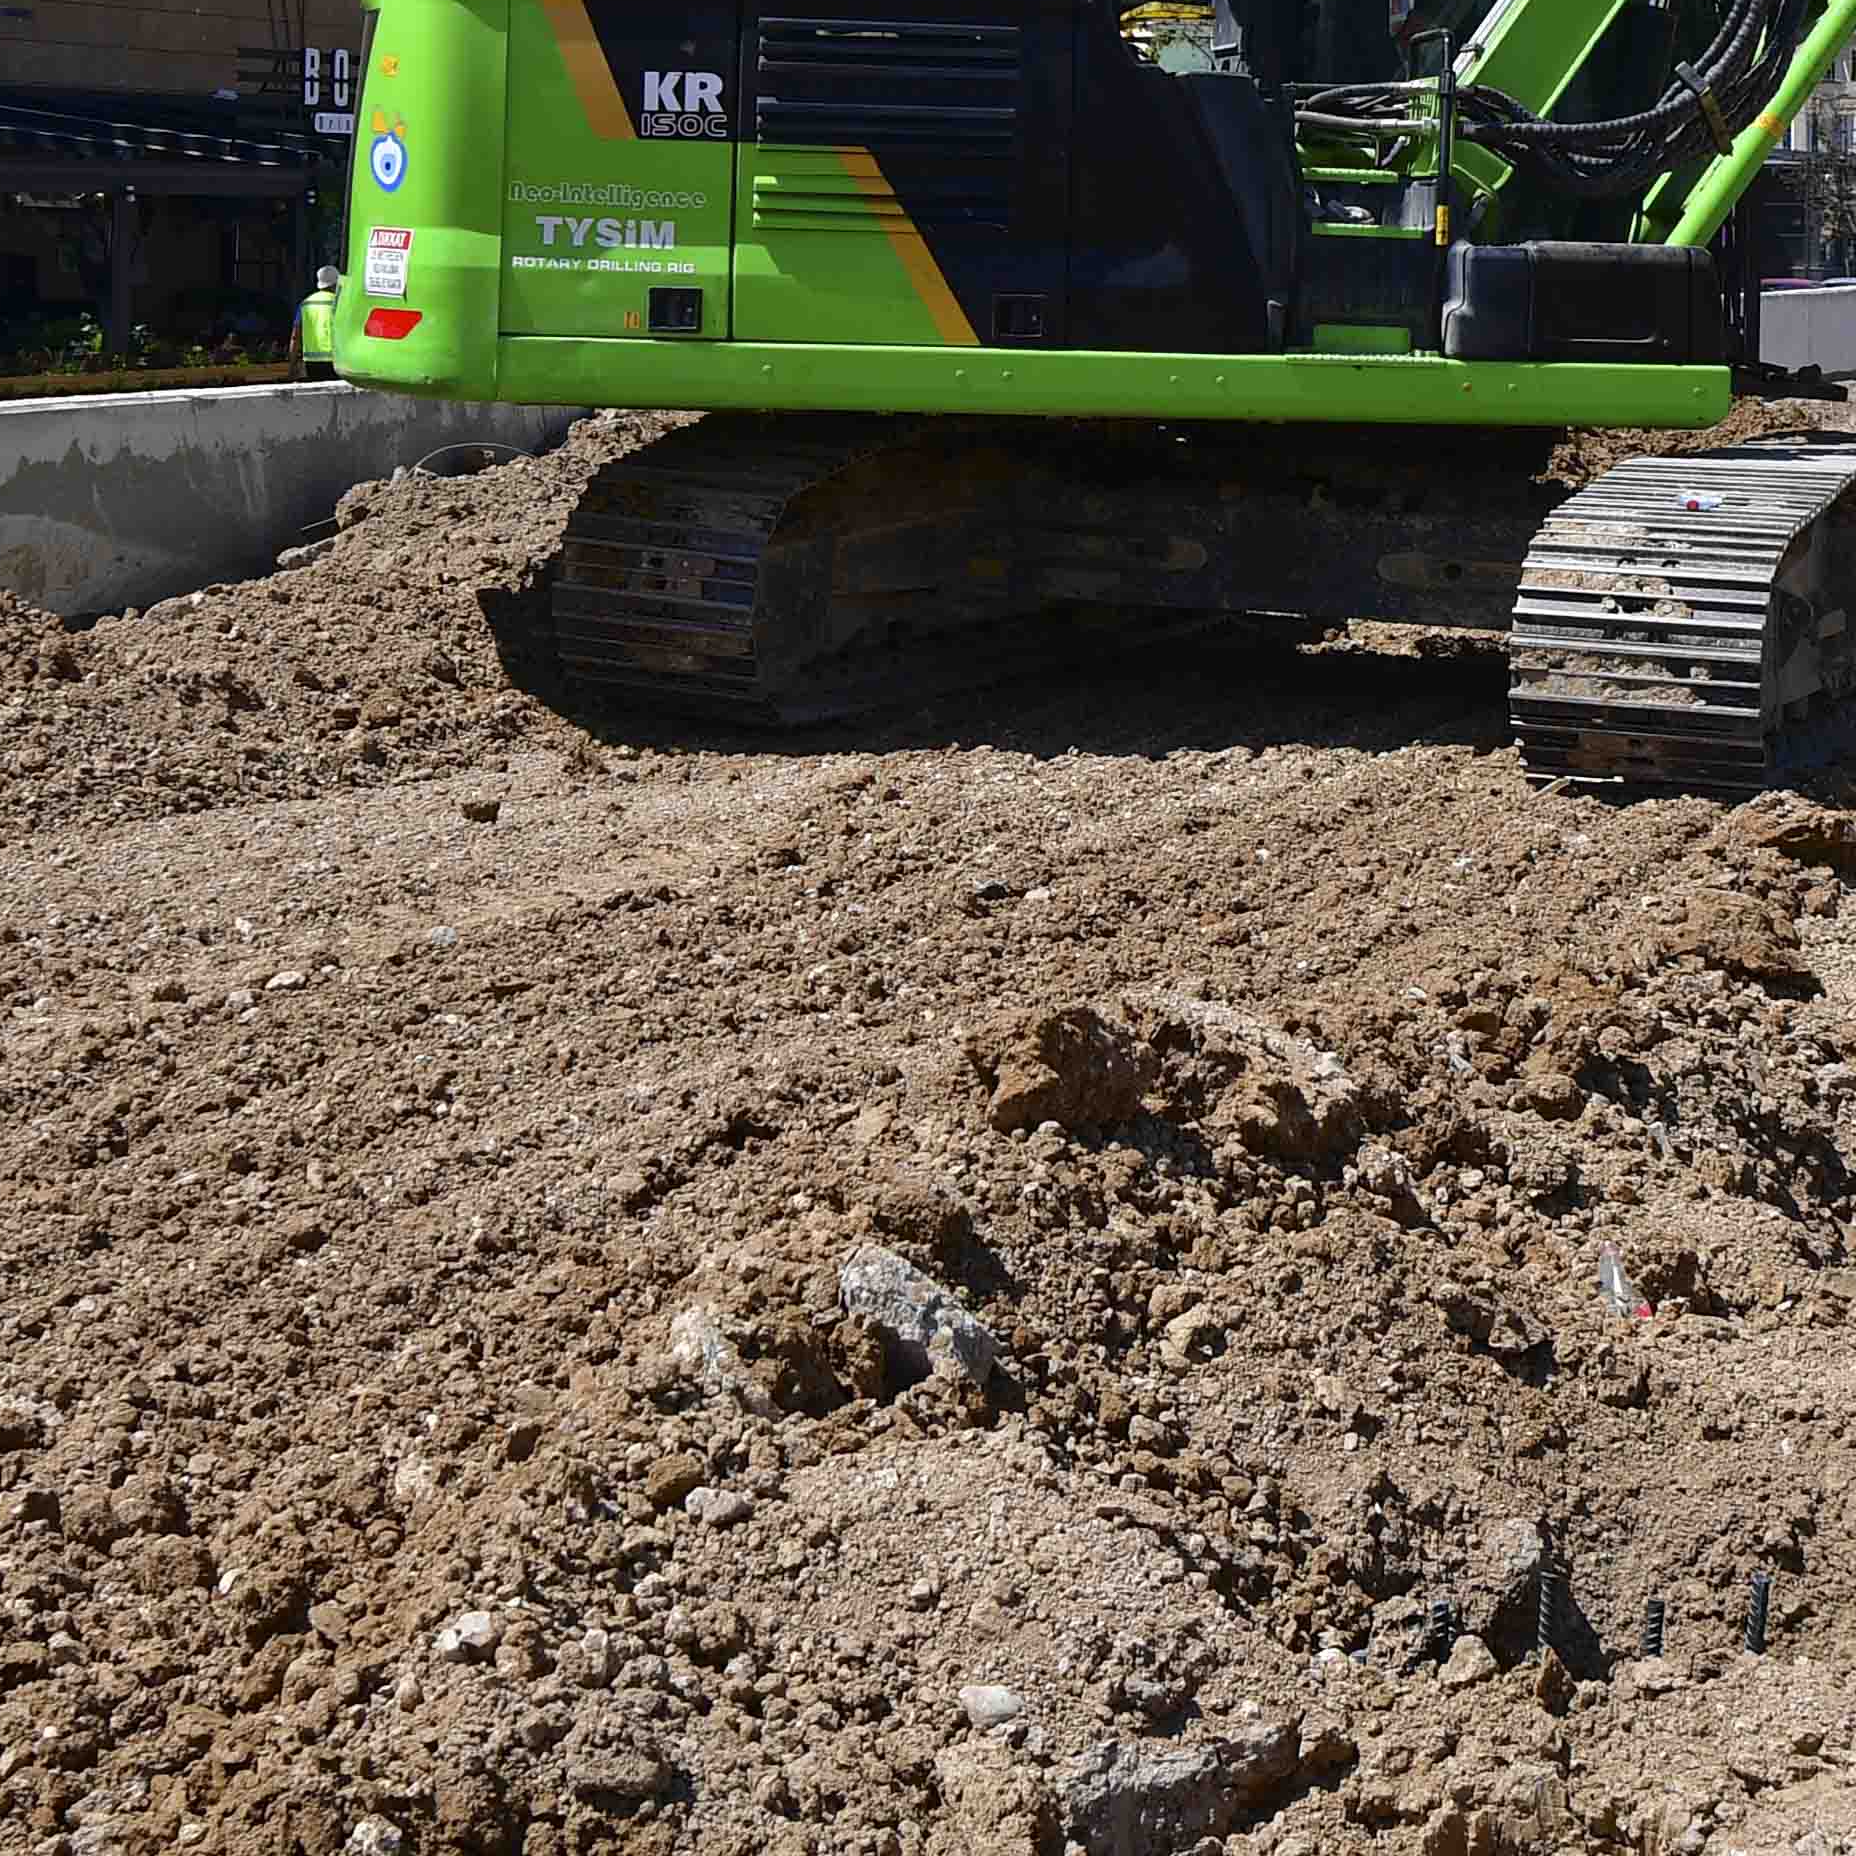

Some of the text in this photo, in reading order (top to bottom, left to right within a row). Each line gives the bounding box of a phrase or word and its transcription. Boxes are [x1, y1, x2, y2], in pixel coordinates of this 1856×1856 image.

[643, 71, 724, 113] KR
[512, 255, 696, 274] ROTARY DRILLING RIG
